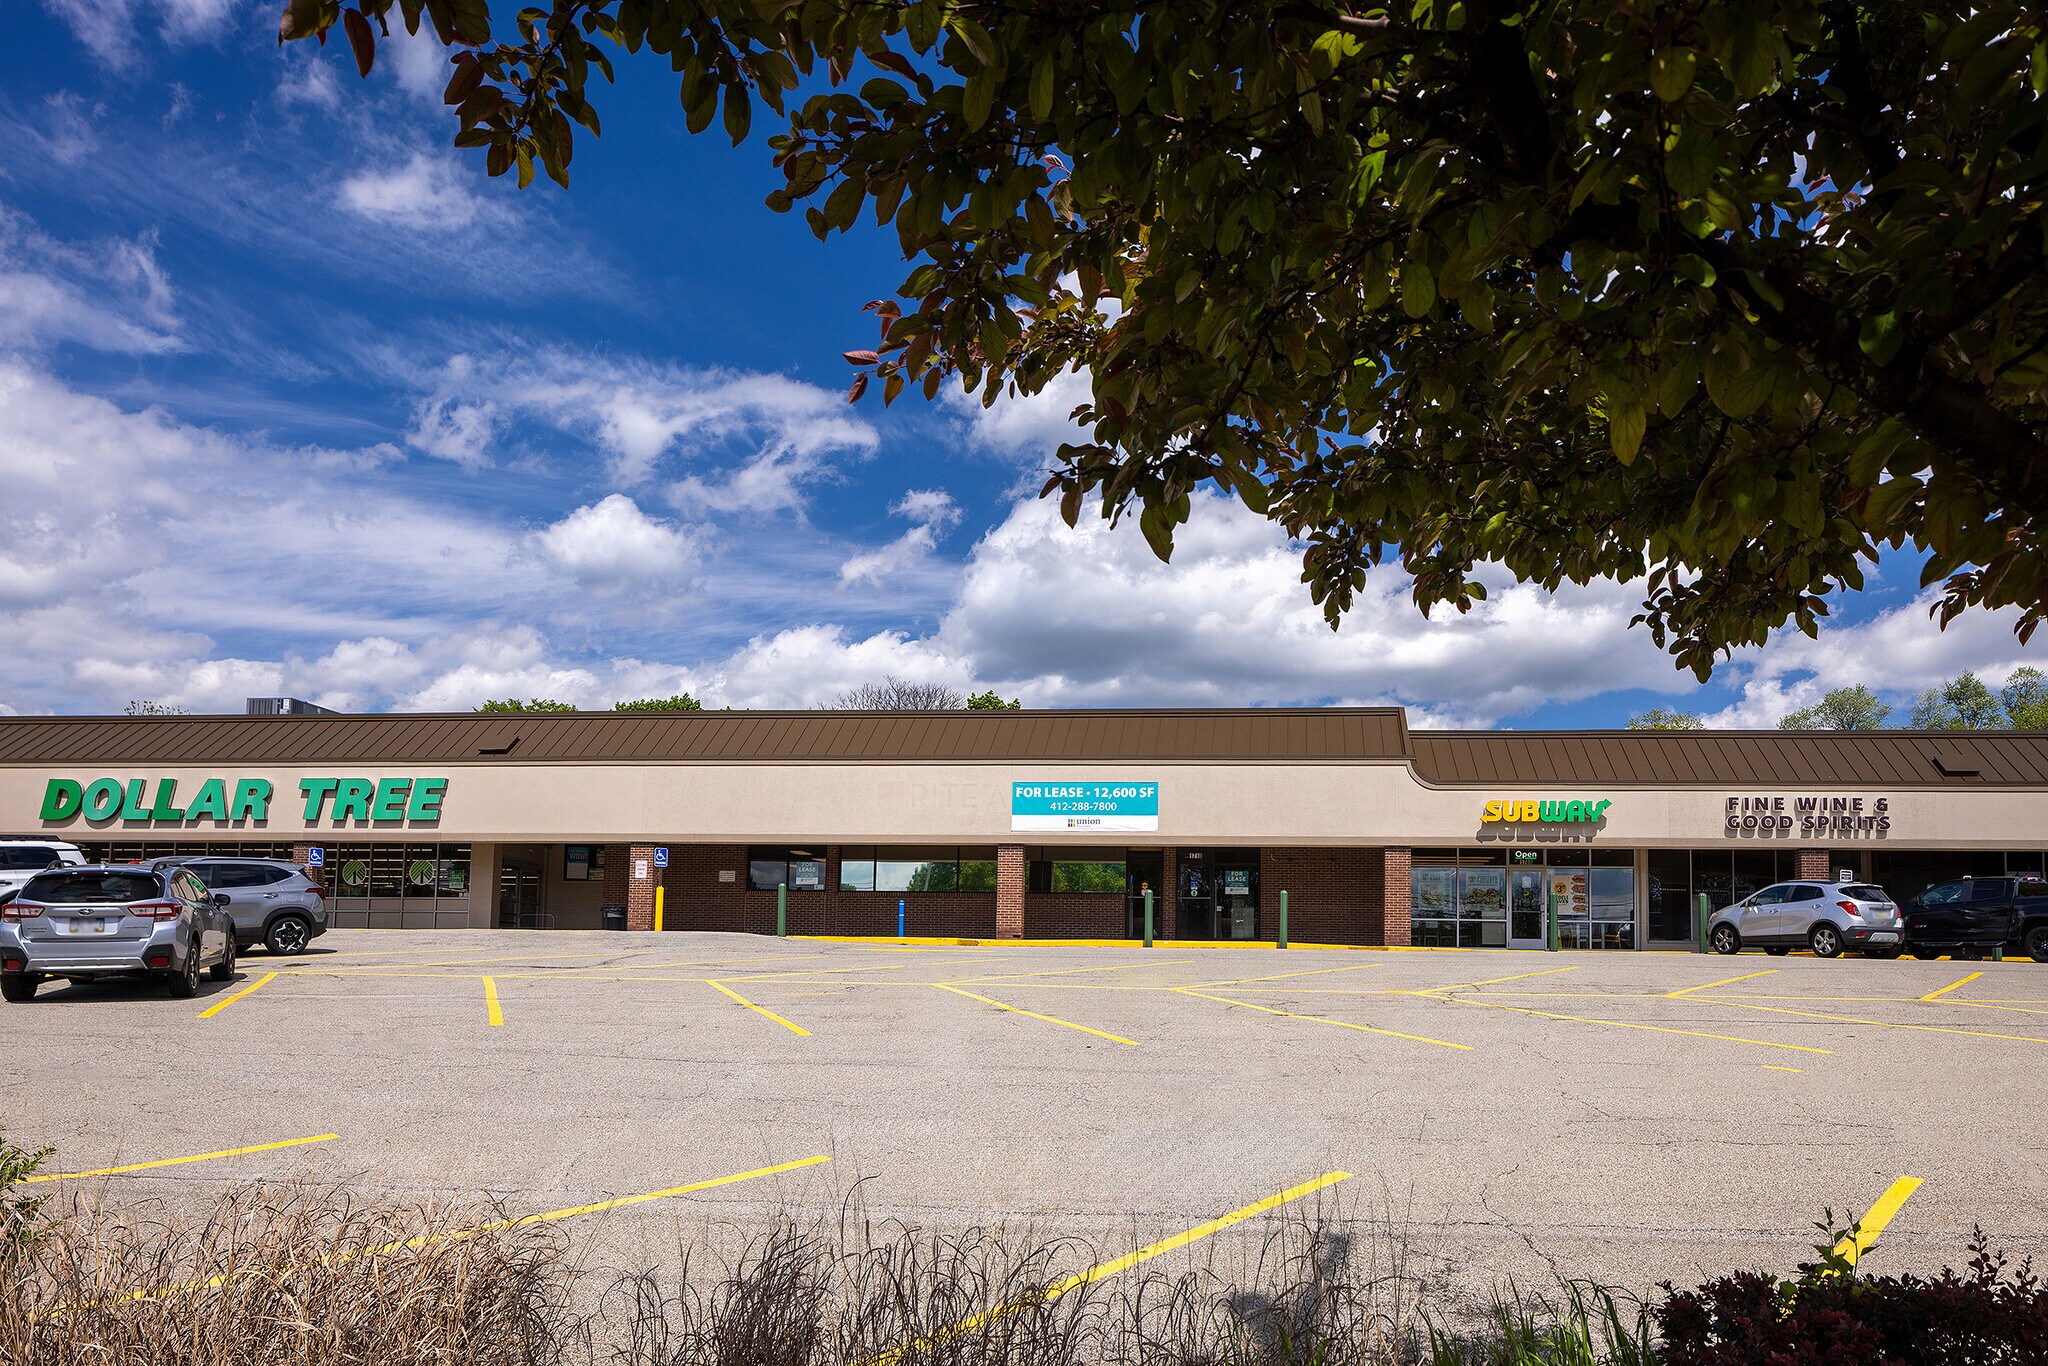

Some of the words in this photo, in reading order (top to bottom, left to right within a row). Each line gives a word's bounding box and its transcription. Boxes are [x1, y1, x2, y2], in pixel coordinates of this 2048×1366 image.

[39, 777, 273, 821] DOLLAR
[299, 777, 448, 821] TREE
[1015, 787, 1042, 798] FOR
[1044, 787, 1084, 798] LEASE
[1093, 787, 1137, 799] 12,600
[1139, 787, 1155, 798] SF
[1050, 802, 1117, 811] 412-288-7800
[1727, 797, 1785, 812] FINE
[1796, 797, 1864, 812] WINE
[1874, 797, 1889, 812] &
[1480, 799, 1612, 824] SUBWAY
[1076, 817, 1101, 825] union
[1726, 815, 1794, 830] GOOD
[1802, 815, 1891, 830] SPIRITS
[1515, 850, 1537, 859] Open
